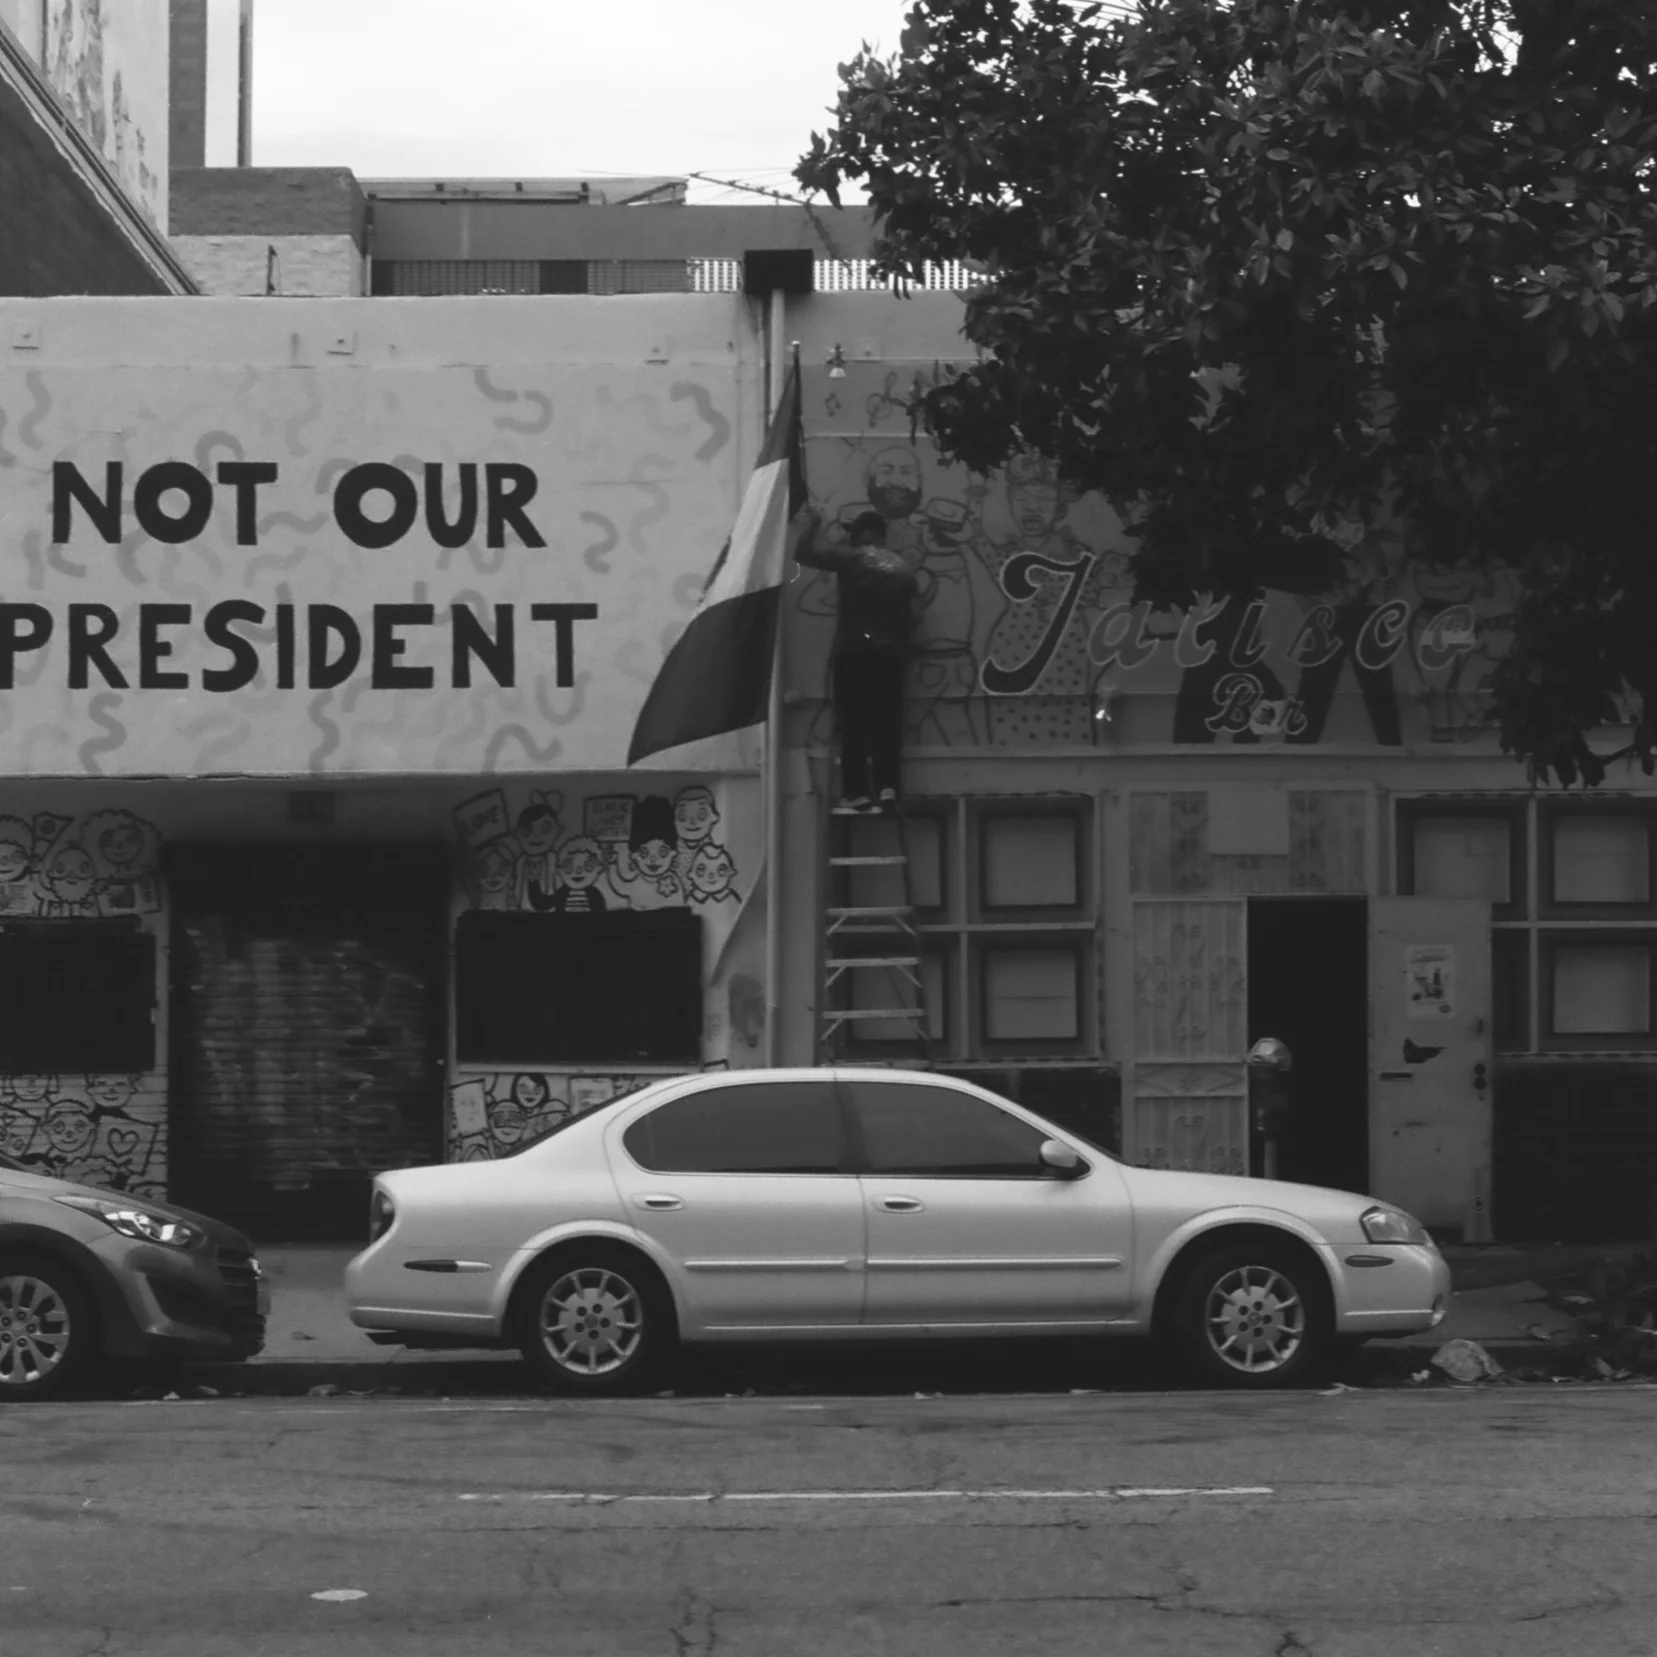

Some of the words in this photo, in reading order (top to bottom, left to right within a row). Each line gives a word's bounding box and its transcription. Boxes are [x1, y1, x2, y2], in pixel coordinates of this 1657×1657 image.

[52, 460, 279, 546] NOT
[333, 461, 548, 550] OUR
[0, 599, 599, 693] PRESIDENT
[1205, 672, 1308, 735] Bar
